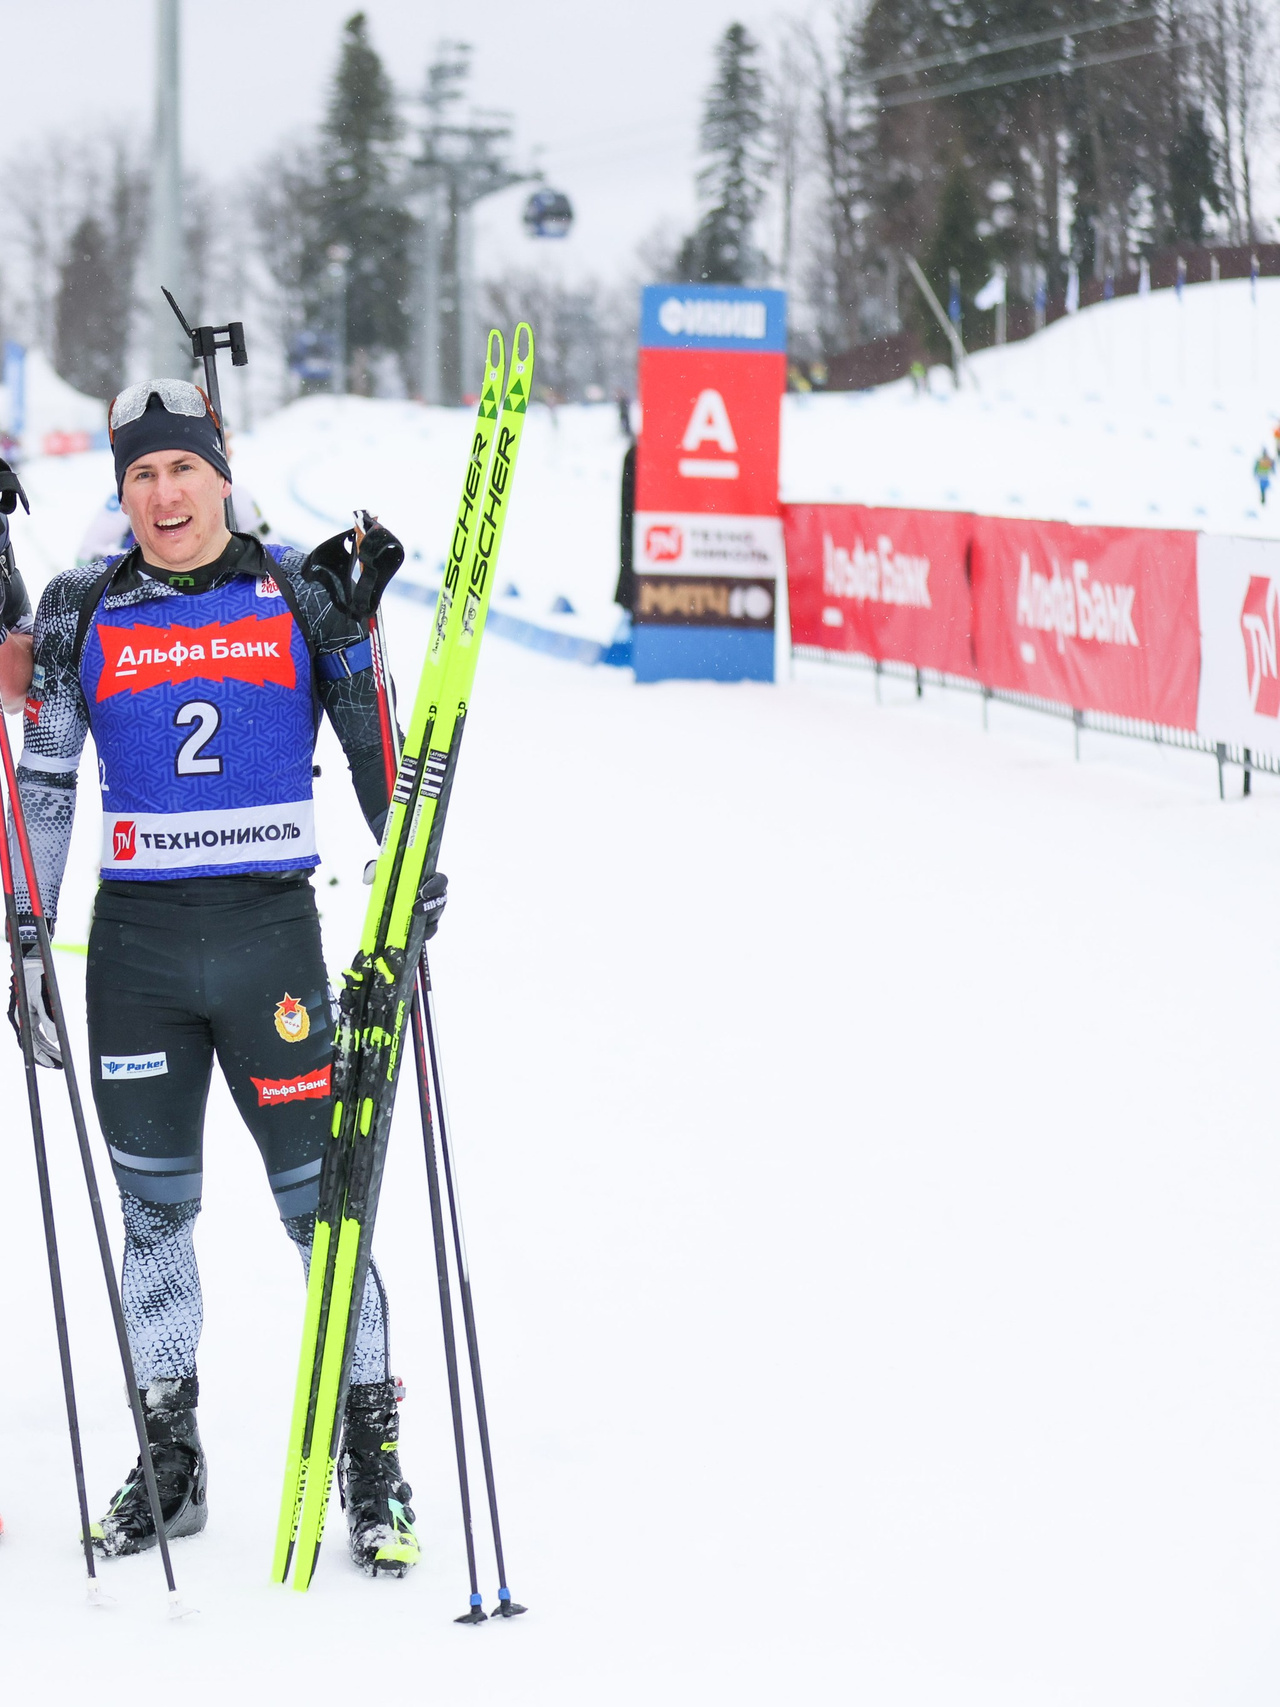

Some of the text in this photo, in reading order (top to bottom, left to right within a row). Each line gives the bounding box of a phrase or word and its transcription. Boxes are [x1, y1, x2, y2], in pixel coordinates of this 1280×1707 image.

[659, 297, 767, 338] ФИНИШ
[117, 639, 281, 667] Альфа Банк
[173, 699, 223, 778] 2
[140, 823, 301, 850] ТЕХНОНИКОЛЬ
[385, 999, 406, 1083] FISCHER
[126, 1059, 166, 1072] Parker
[262, 1077, 328, 1097] Альфа Банк
